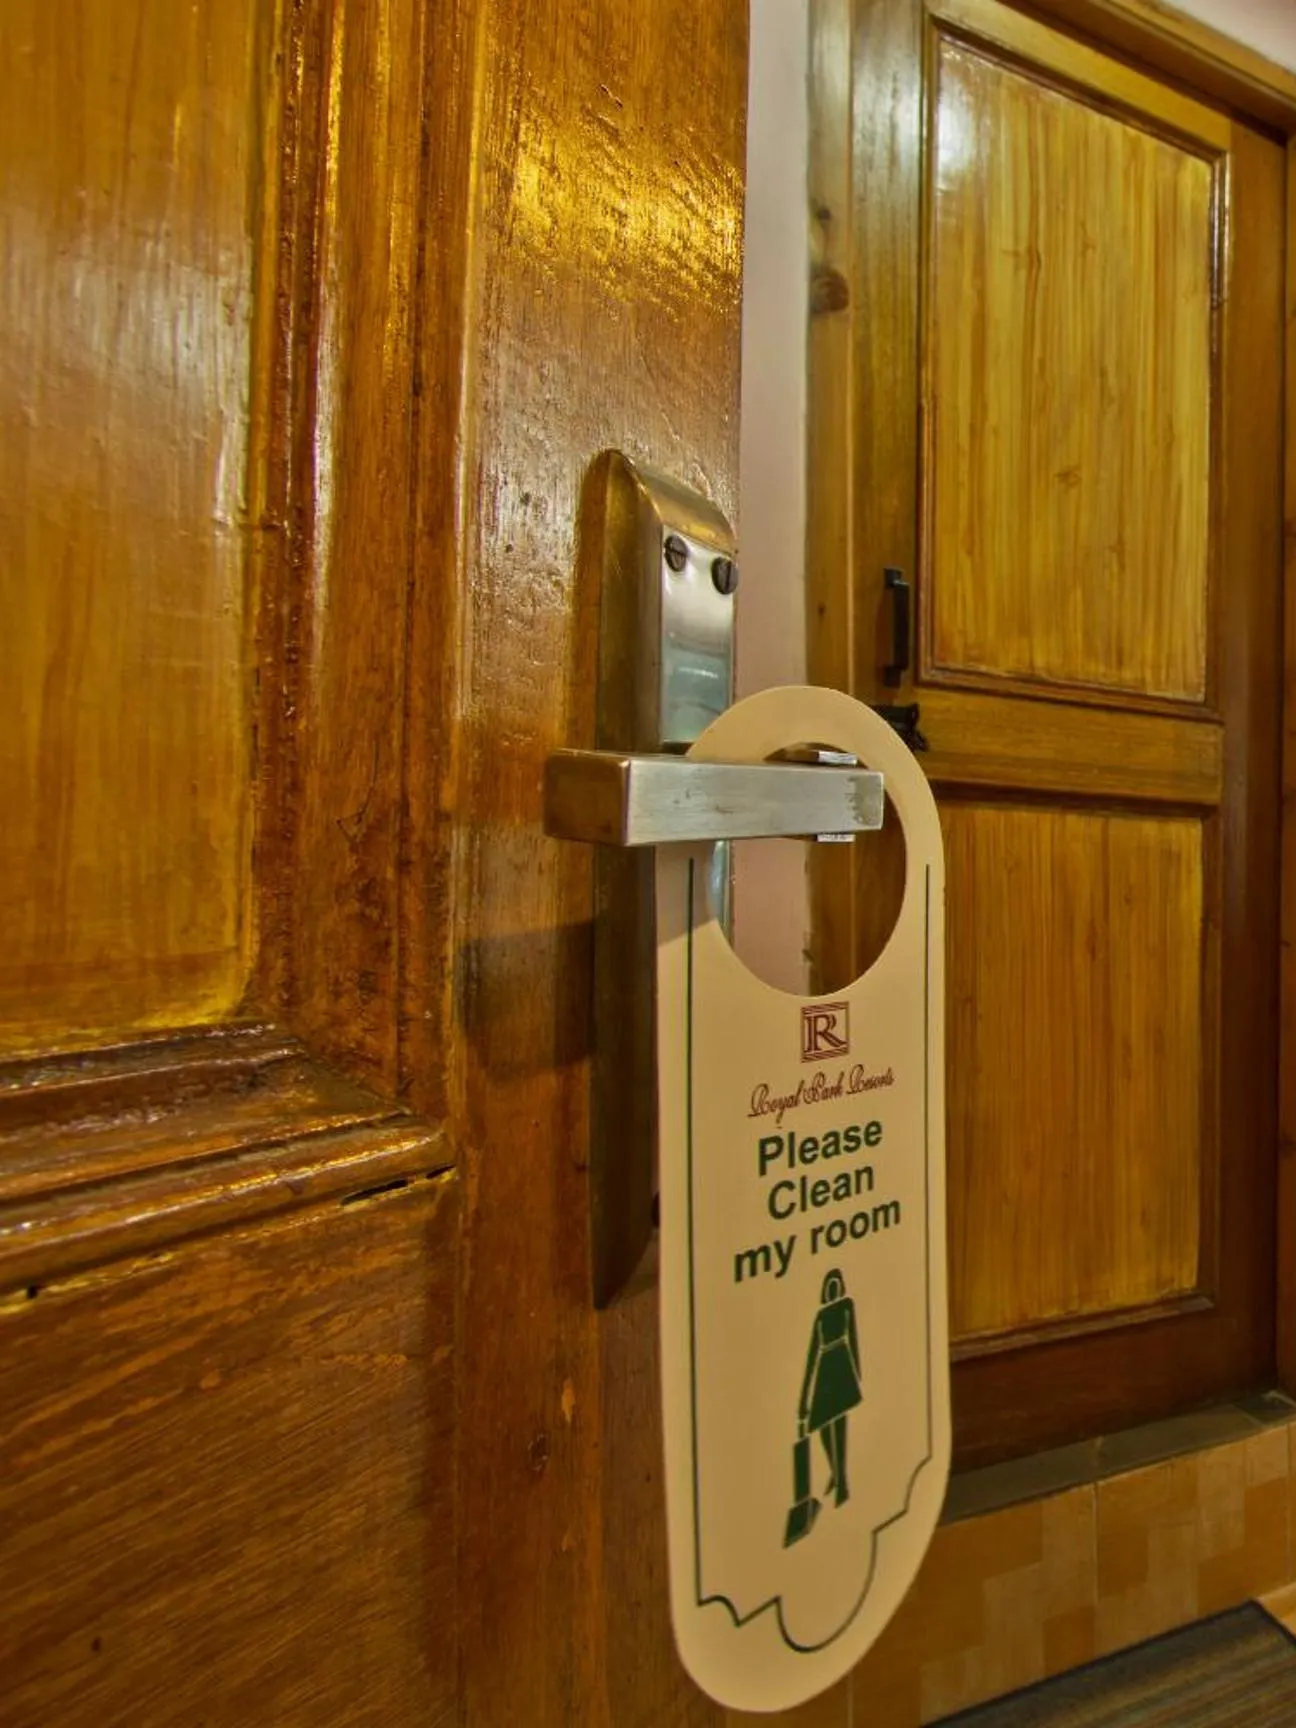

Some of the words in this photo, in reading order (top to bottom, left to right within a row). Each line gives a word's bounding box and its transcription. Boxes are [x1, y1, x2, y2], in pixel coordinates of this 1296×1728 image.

[747, 1080, 804, 1125] Royal
[803, 1071, 844, 1105] Park
[758, 1120, 882, 1177] Please
[768, 1165, 874, 1220] Clean
[734, 1235, 797, 1283] my
[810, 1200, 901, 1255] room
